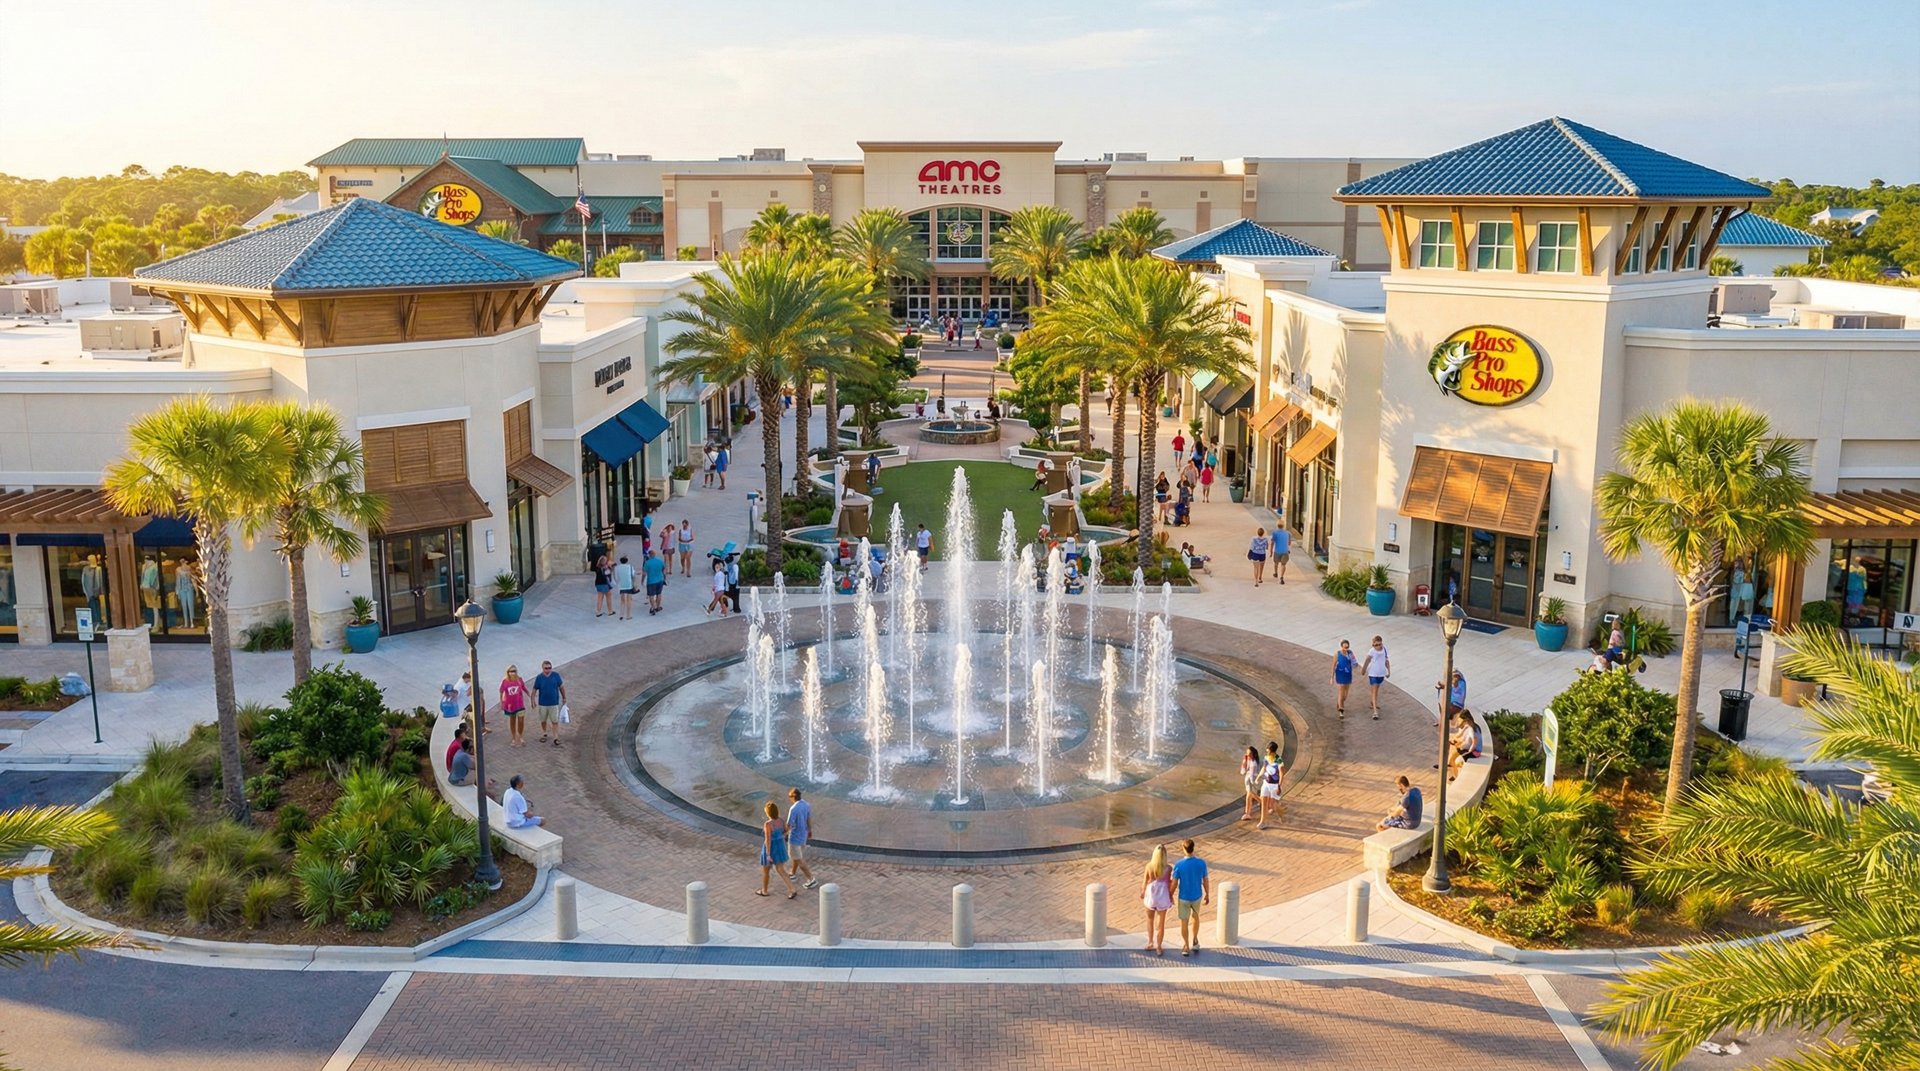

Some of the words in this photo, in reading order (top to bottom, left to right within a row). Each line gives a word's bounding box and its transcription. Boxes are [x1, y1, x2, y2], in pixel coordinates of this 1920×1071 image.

[443, 186, 468, 197] Bass
[918, 184, 1002, 195] THEATRES
[444, 196, 462, 209] Pro
[444, 208, 476, 222] Shops
[1470, 330, 1516, 353] Bass
[1471, 352, 1505, 372] Pro
[1471, 370, 1525, 397] Shops
